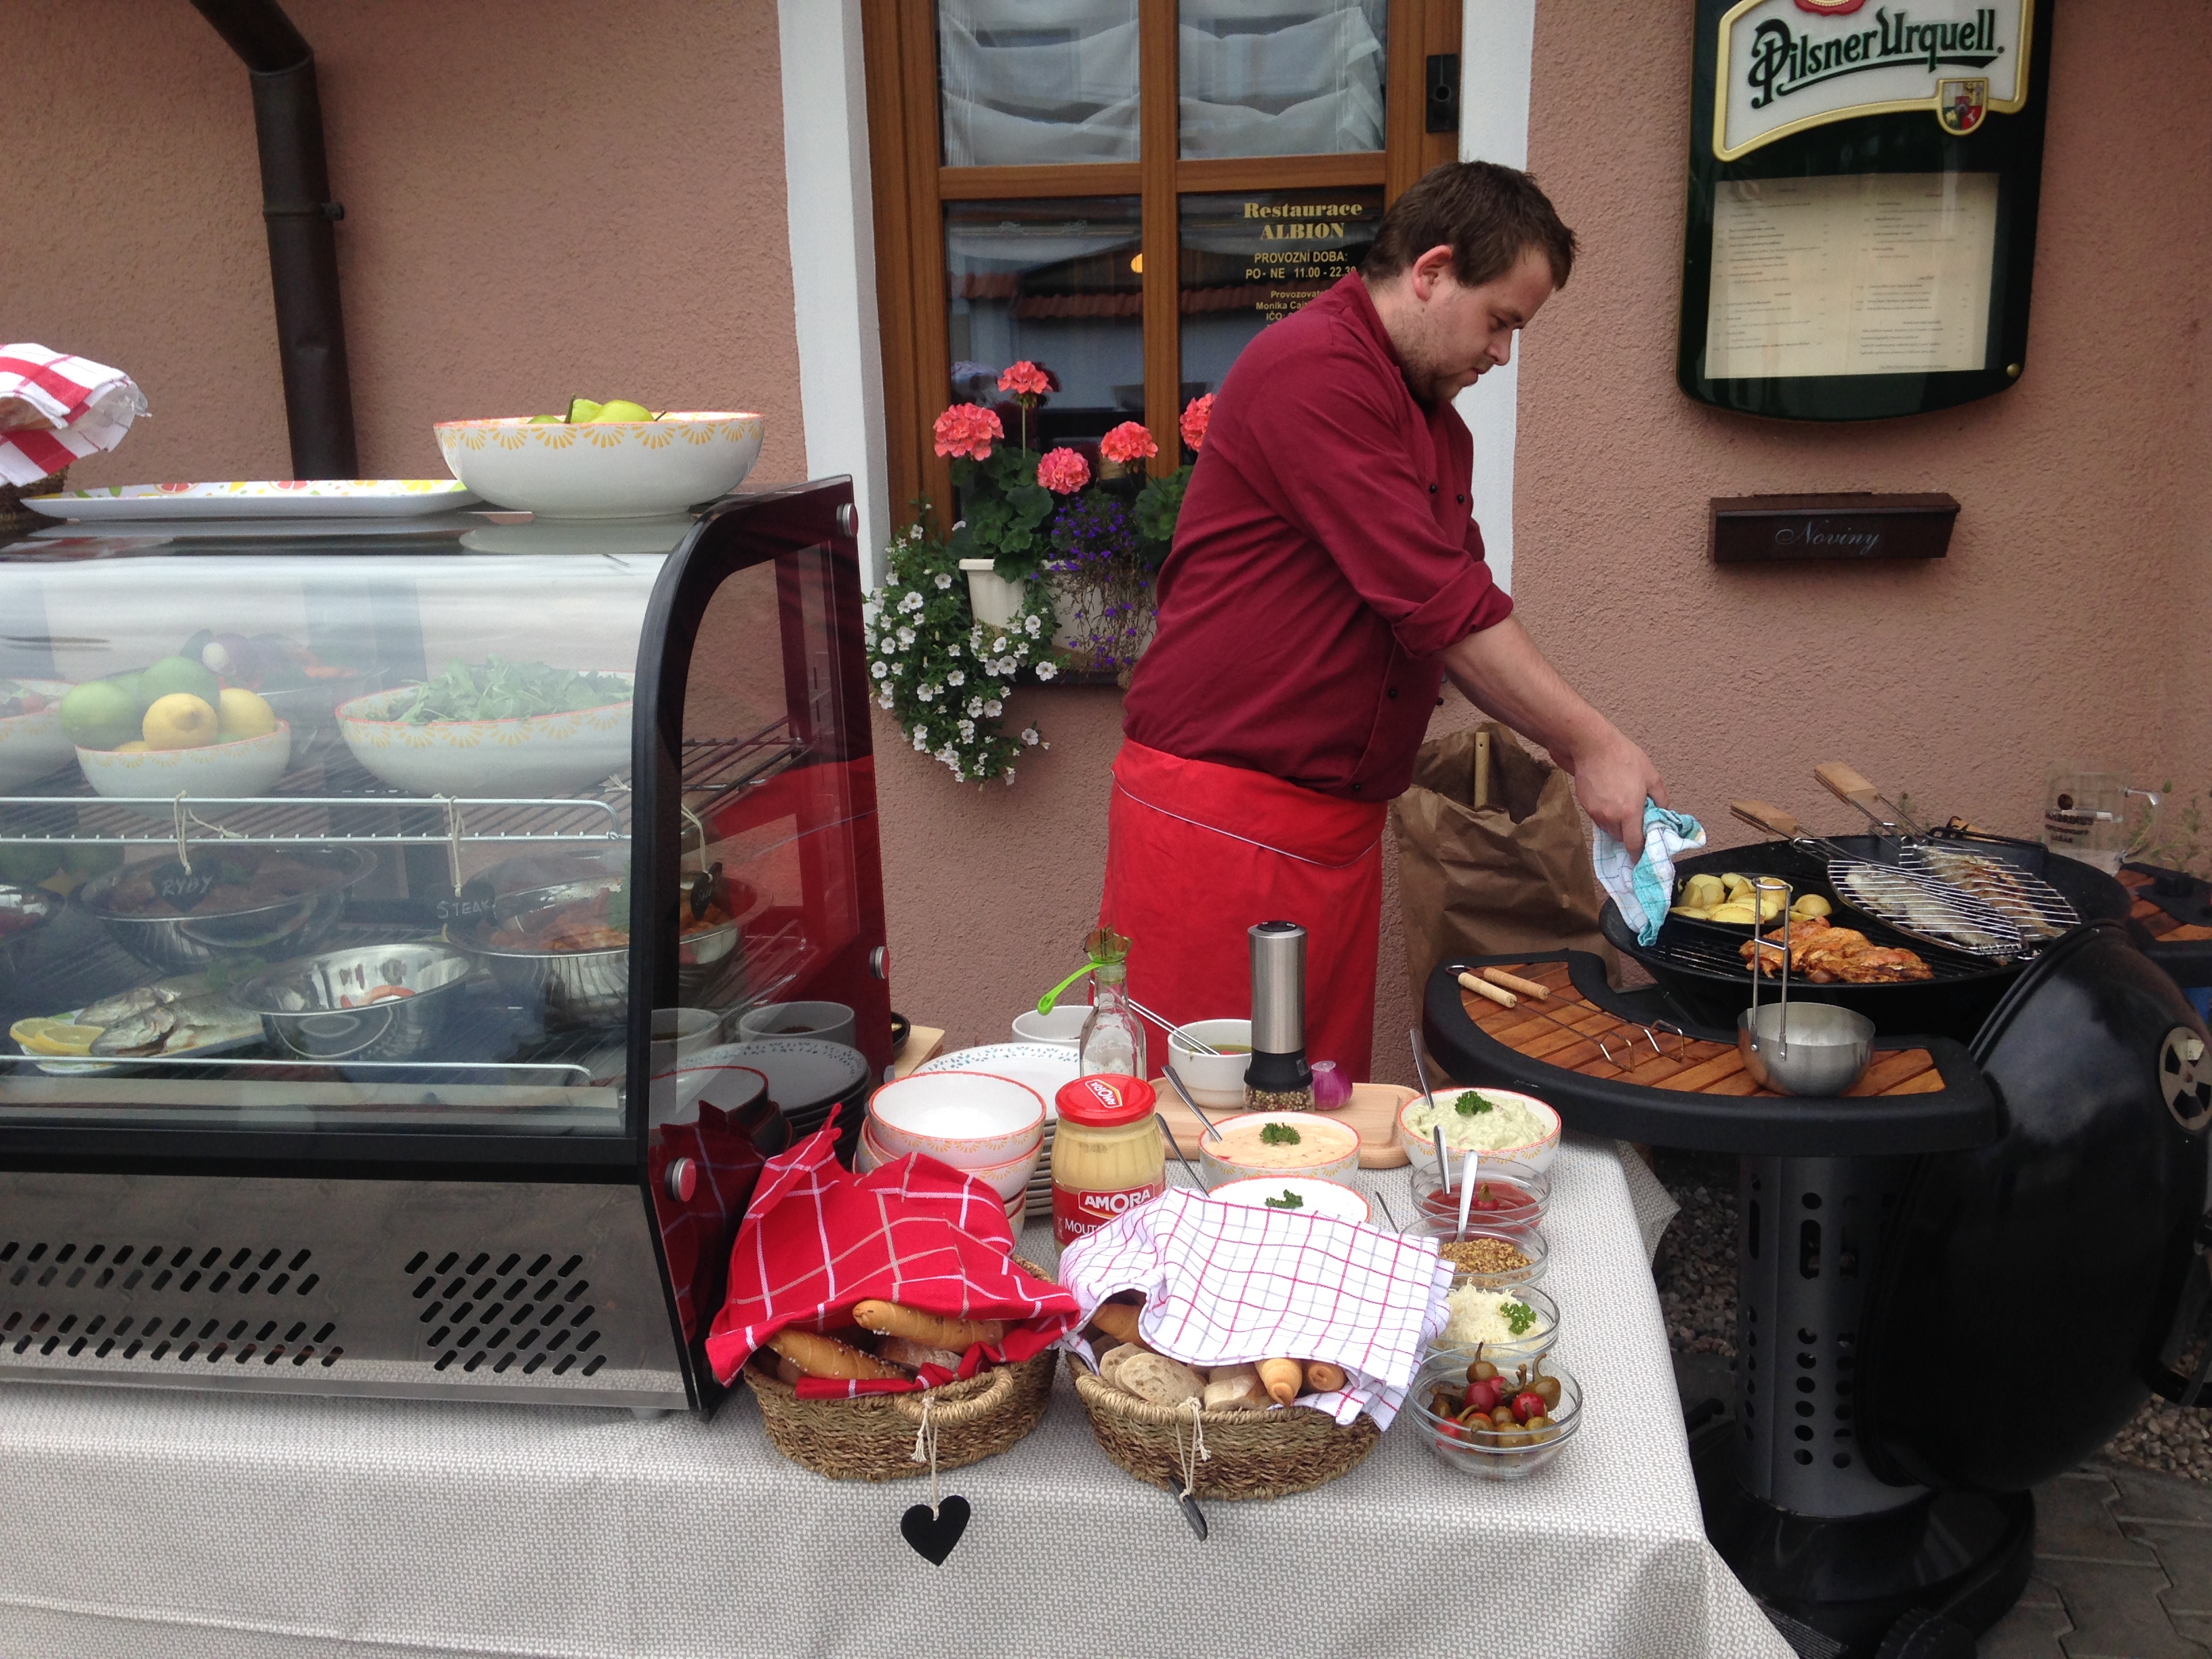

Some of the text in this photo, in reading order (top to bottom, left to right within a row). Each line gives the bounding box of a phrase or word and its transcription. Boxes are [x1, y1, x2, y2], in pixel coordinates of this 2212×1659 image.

[1748, 19, 1878, 109] Pilsner
[1244, 203, 1363, 219] Restaurace
[1260, 222, 1345, 240] ALBION
[1254, 249, 1348, 264] PROVOZNÍ DOBA:
[1271, 268, 1286, 279] NE
[1294, 267, 1321, 278] 11.00
[1271, 289, 1328, 298] Provozovat
[1256, 302, 1288, 310] Monika
[1775, 520, 1880, 555] Noviny
[162, 875, 213, 897] RYBY
[1090, 1082, 1116, 1105] AMORA
[1084, 1189, 1151, 1214] AMORA
[1065, 1217, 1099, 1235] MOUT
